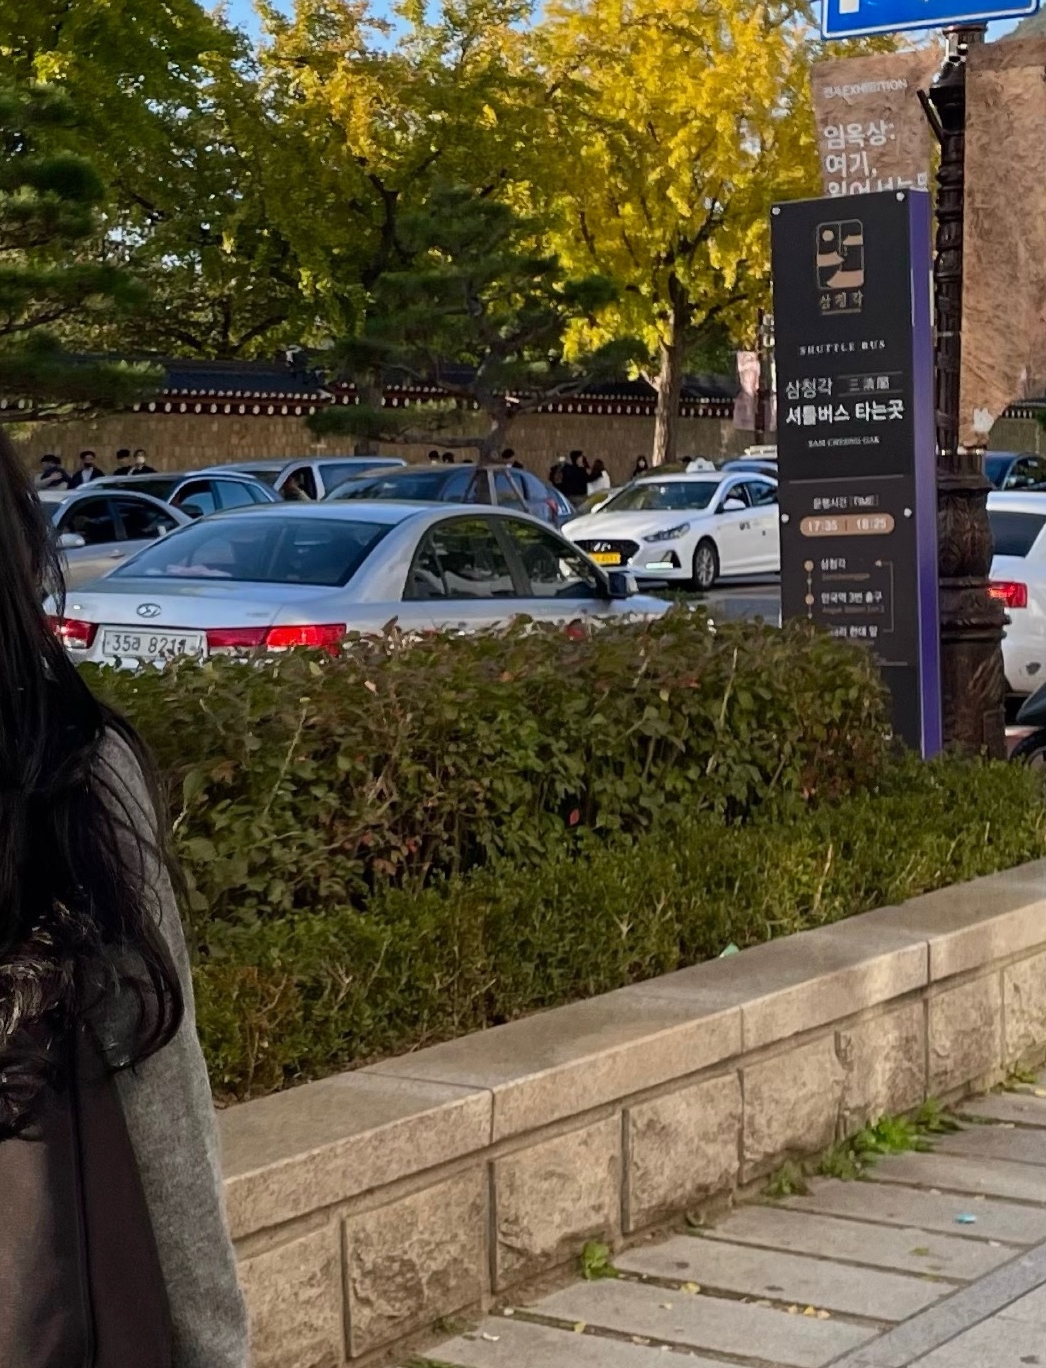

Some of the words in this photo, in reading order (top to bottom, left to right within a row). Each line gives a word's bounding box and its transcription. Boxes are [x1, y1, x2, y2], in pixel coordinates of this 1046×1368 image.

[824, 120, 894, 149] 임옥상:
[825, 151, 877, 178] 여기,
[799, 342, 855, 356] SHUTTLE
[861, 339, 886, 350] BUS
[785, 377, 833, 400] 삼청각
[785, 404, 851, 426] 셔틀버스
